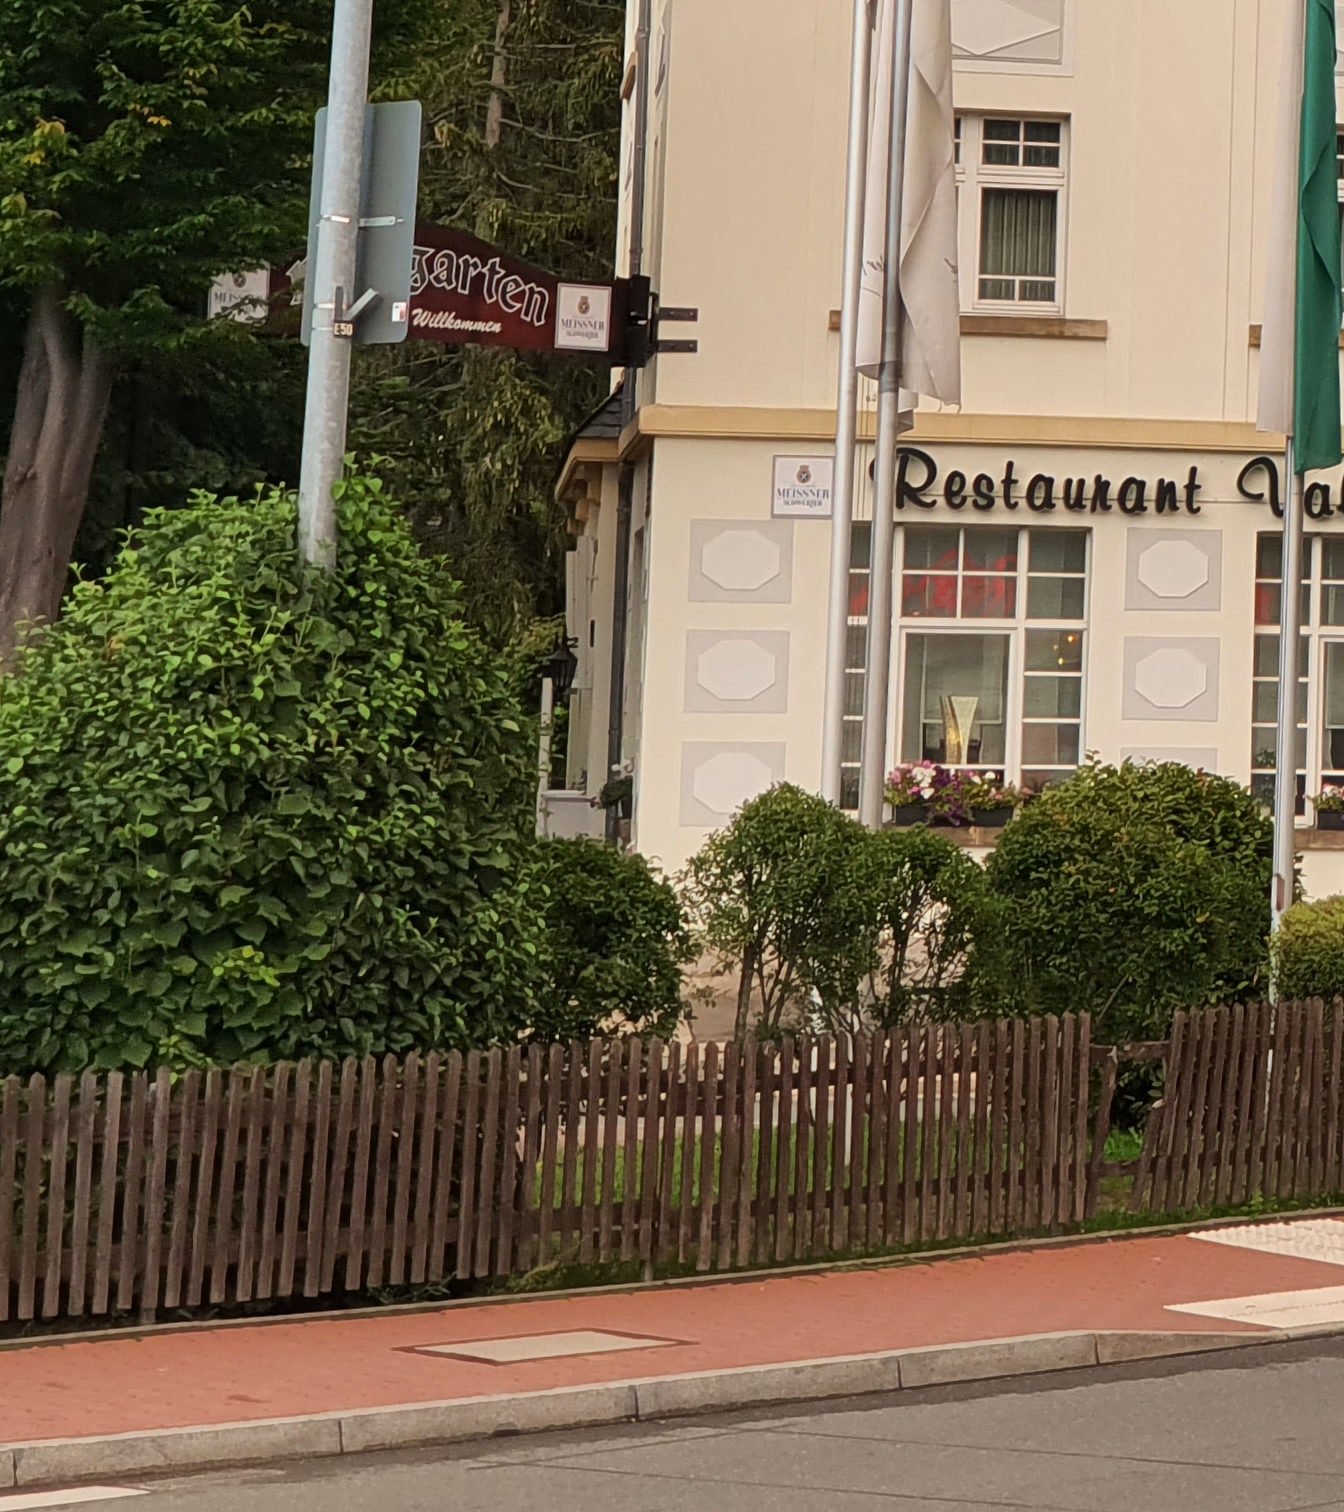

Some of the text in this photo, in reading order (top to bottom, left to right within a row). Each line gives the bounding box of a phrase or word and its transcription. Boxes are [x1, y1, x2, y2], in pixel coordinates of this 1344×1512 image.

[411, 308, 502, 334] Willkommen
[561, 318, 605, 331] MEISSNER
[869, 447, 1201, 515] Restaurant
[777, 488, 830, 499] MEISSNER
